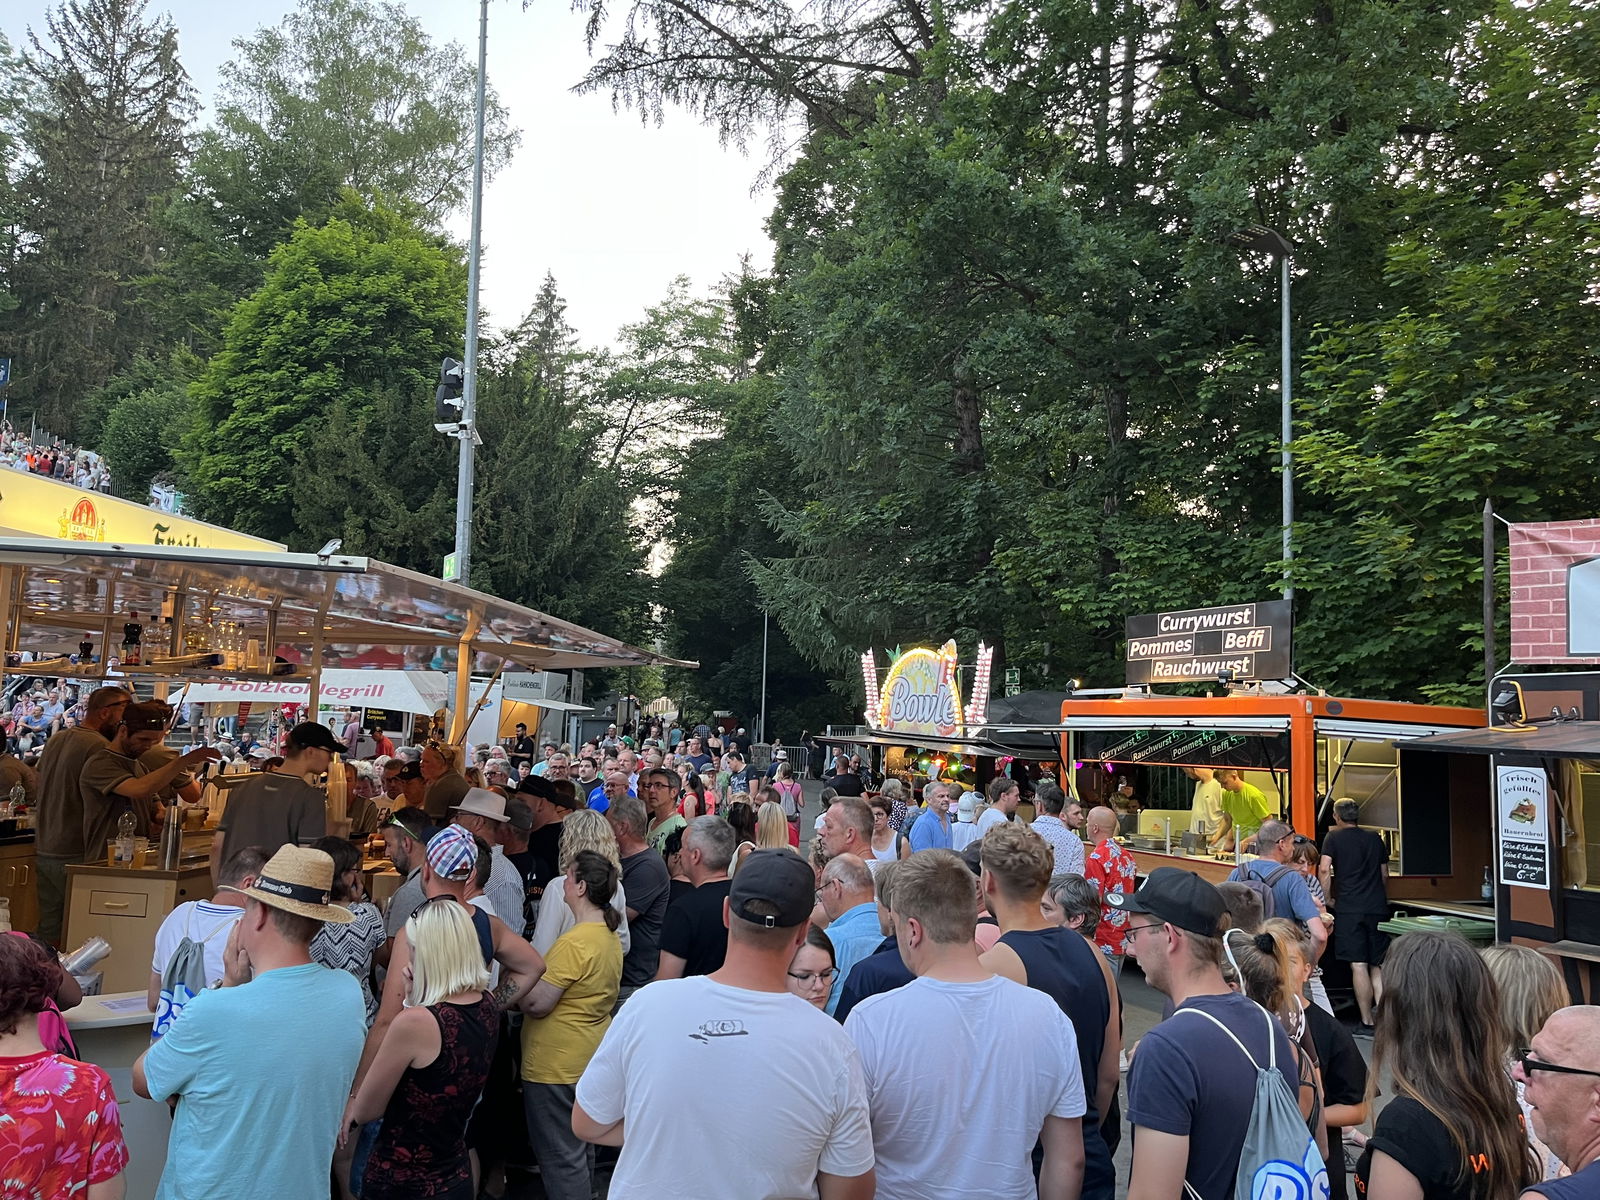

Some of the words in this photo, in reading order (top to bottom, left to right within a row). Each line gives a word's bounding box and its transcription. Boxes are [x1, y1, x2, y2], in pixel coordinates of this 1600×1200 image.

[1160, 608, 1251, 632] Currywurst
[1130, 638, 1192, 656] Pommes
[1225, 630, 1265, 649] Beffi
[1154, 657, 1250, 677] Rauchwurst
[888, 676, 955, 726] Bowle
[1100, 737, 1135, 760] Currywurst
[1132, 735, 1172, 761] Rauchwurst
[1172, 737, 1203, 757] Pommes
[1211, 740, 1229, 755] Beffi
[1506, 775, 1537, 784] frisch
[1503, 785, 1541, 796] gefülltes
